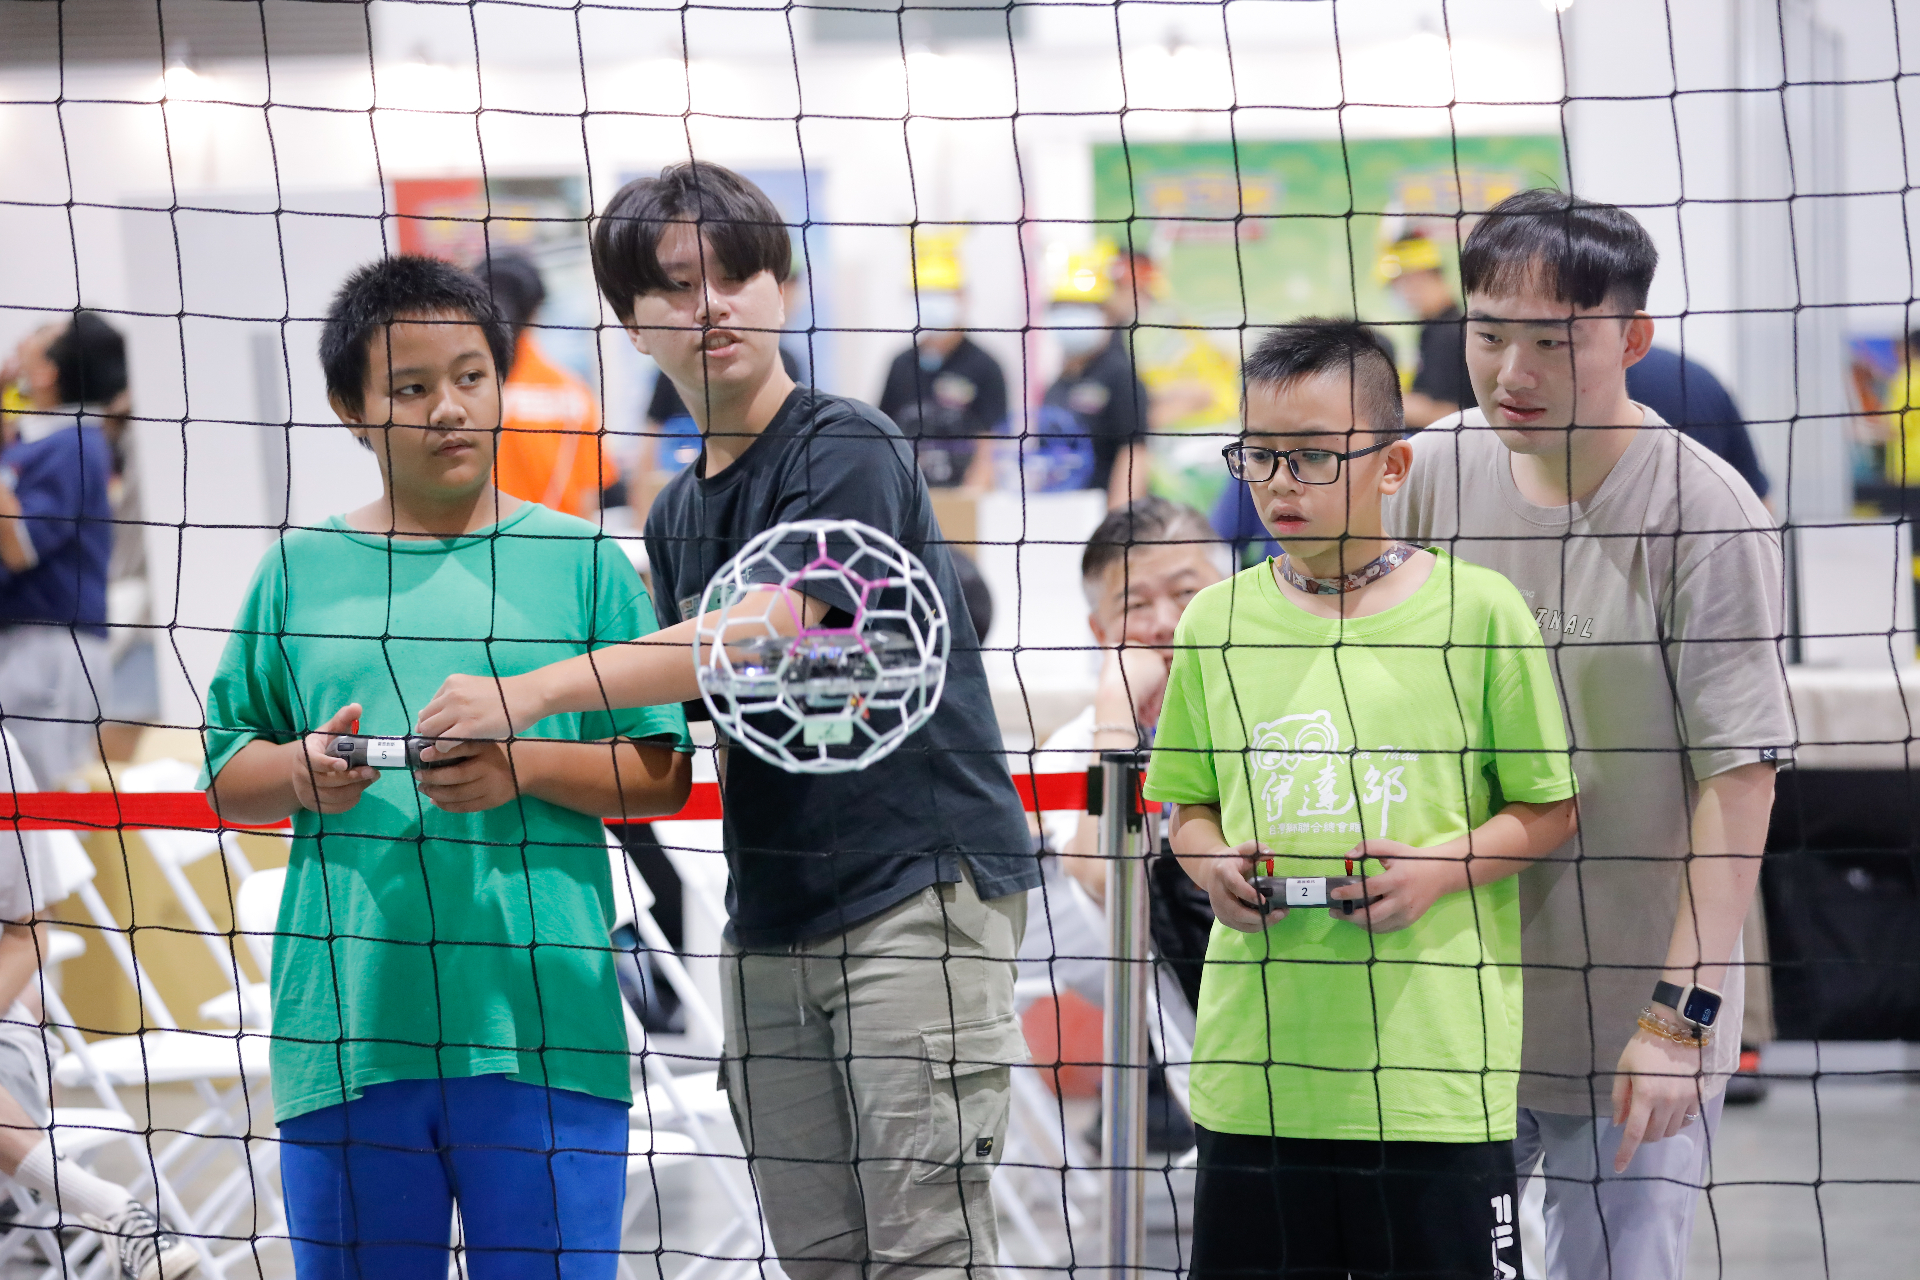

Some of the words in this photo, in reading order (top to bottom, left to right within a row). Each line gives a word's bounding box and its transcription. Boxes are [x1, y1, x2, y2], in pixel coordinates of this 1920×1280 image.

[381, 750, 388, 760] 5
[1261, 764, 1408, 838] 伊達邵
[1301, 887, 1309, 897] 2
